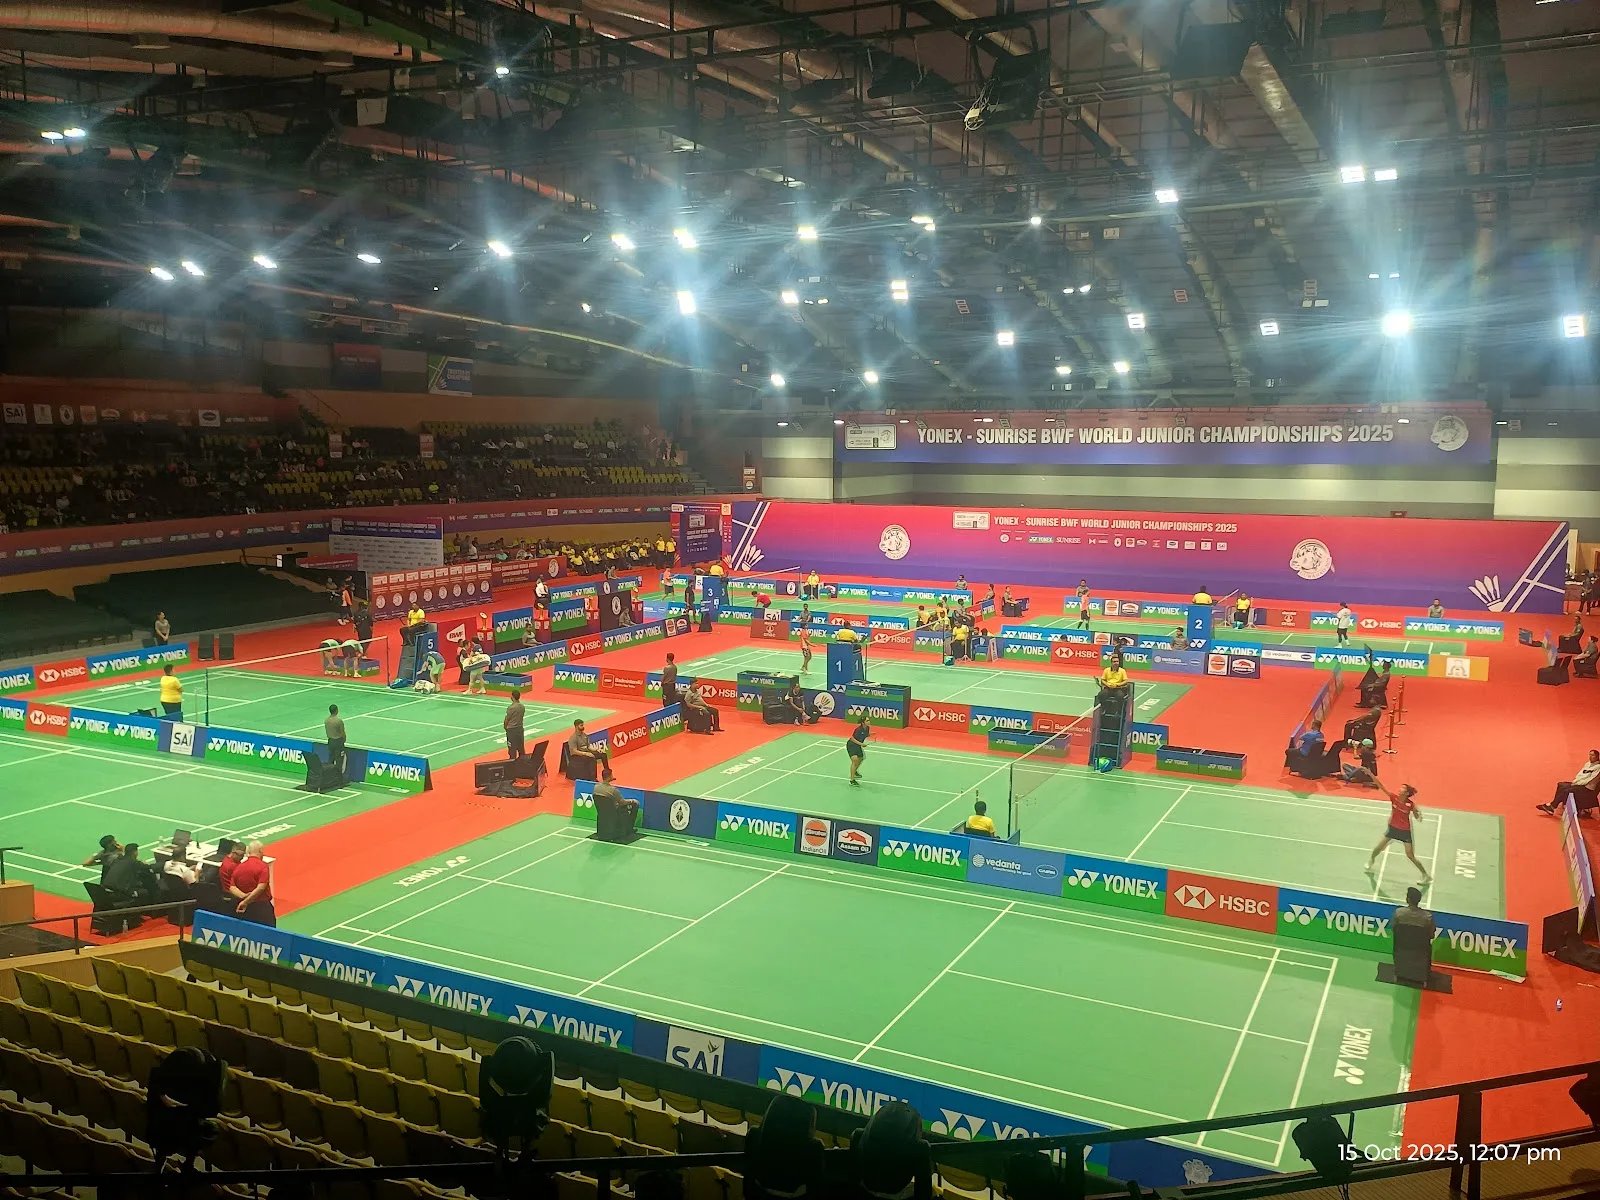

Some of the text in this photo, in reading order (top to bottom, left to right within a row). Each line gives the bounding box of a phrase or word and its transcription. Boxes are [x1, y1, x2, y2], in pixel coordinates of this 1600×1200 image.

[917, 428, 963, 444] YONEX
[976, 428, 1037, 444] SUNRISE
[1041, 427, 1075, 444] BWF
[1079, 427, 1134, 444] WORLD
[1136, 426, 1195, 443] JUNIOR
[1200, 425, 1343, 443] CHAMPIONSHIPS
[1347, 424, 1394, 442] 2025
[994, 516, 1020, 526] YONEX
[1026, 517, 1059, 527] SUNRISE
[1061, 518, 1079, 528] BWF
[1081, 519, 1109, 529] WORLD
[1111, 520, 1141, 530] JUNIOR
[1142, 521, 1214, 532] CHAMPIONSHIPS
[1215, 523, 1237, 533] 2025
[707, 588, 713, 597] 3
[850, 588, 869, 596] YONEX
[916, 592, 935, 600] YONEX
[565, 607, 585, 620] YONEX
[732, 611, 753, 620] YONEX
[1157, 606, 1180, 616] YONEX
[1195, 619, 1203, 629] 2
[1380, 621, 1402, 629] HSBC
[1423, 623, 1501, 635] YONEX YONEX
[615, 625, 662, 644] YONEX YONEX
[891, 634, 911, 644] HSBC
[1018, 631, 1043, 640] YONEX
[427, 638, 434, 649] 5
[1022, 645, 1048, 656] YONEX
[508, 647, 567, 669] YONEX YONEX
[1075, 650, 1098, 659] HSBC
[1230, 646, 1259, 656] YONEX
[109, 649, 188, 671] YONEX YONEX
[836, 660, 842, 672] 1
[1337, 654, 1425, 670] YONEX YONEX
[61, 666, 86, 678] HSBC
[571, 672, 596, 684] YONEX
[718, 689, 738, 698] HSB
[3, 706, 25, 721] YONEX
[868, 705, 899, 720] YONEX
[938, 711, 966, 723] HSBC
[46, 714, 68, 726] HSBC
[661, 713, 681, 729] YONEX
[994, 716, 1028, 730] YONEX
[85, 720, 156, 741] YONEX YONEX
[629, 727, 647, 741] HSBC
[173, 732, 193, 747] SAI
[225, 740, 256, 756] YONEX
[388, 763, 421, 782] YONEX
[746, 817, 790, 840] YONEX
[912, 843, 962, 867] YONEX
[985, 858, 1021, 870] vedanta
[1102, 873, 1159, 899] YONEX
[1219, 893, 1271, 917] HSBC
[1323, 909, 1391, 938] YONEX
[1446, 928, 1518, 959] YONEX
[427, 983, 493, 1017] YONEX
[1338, 1024, 1373, 1062] YONEX
[671, 1045, 721, 1077] SAI
